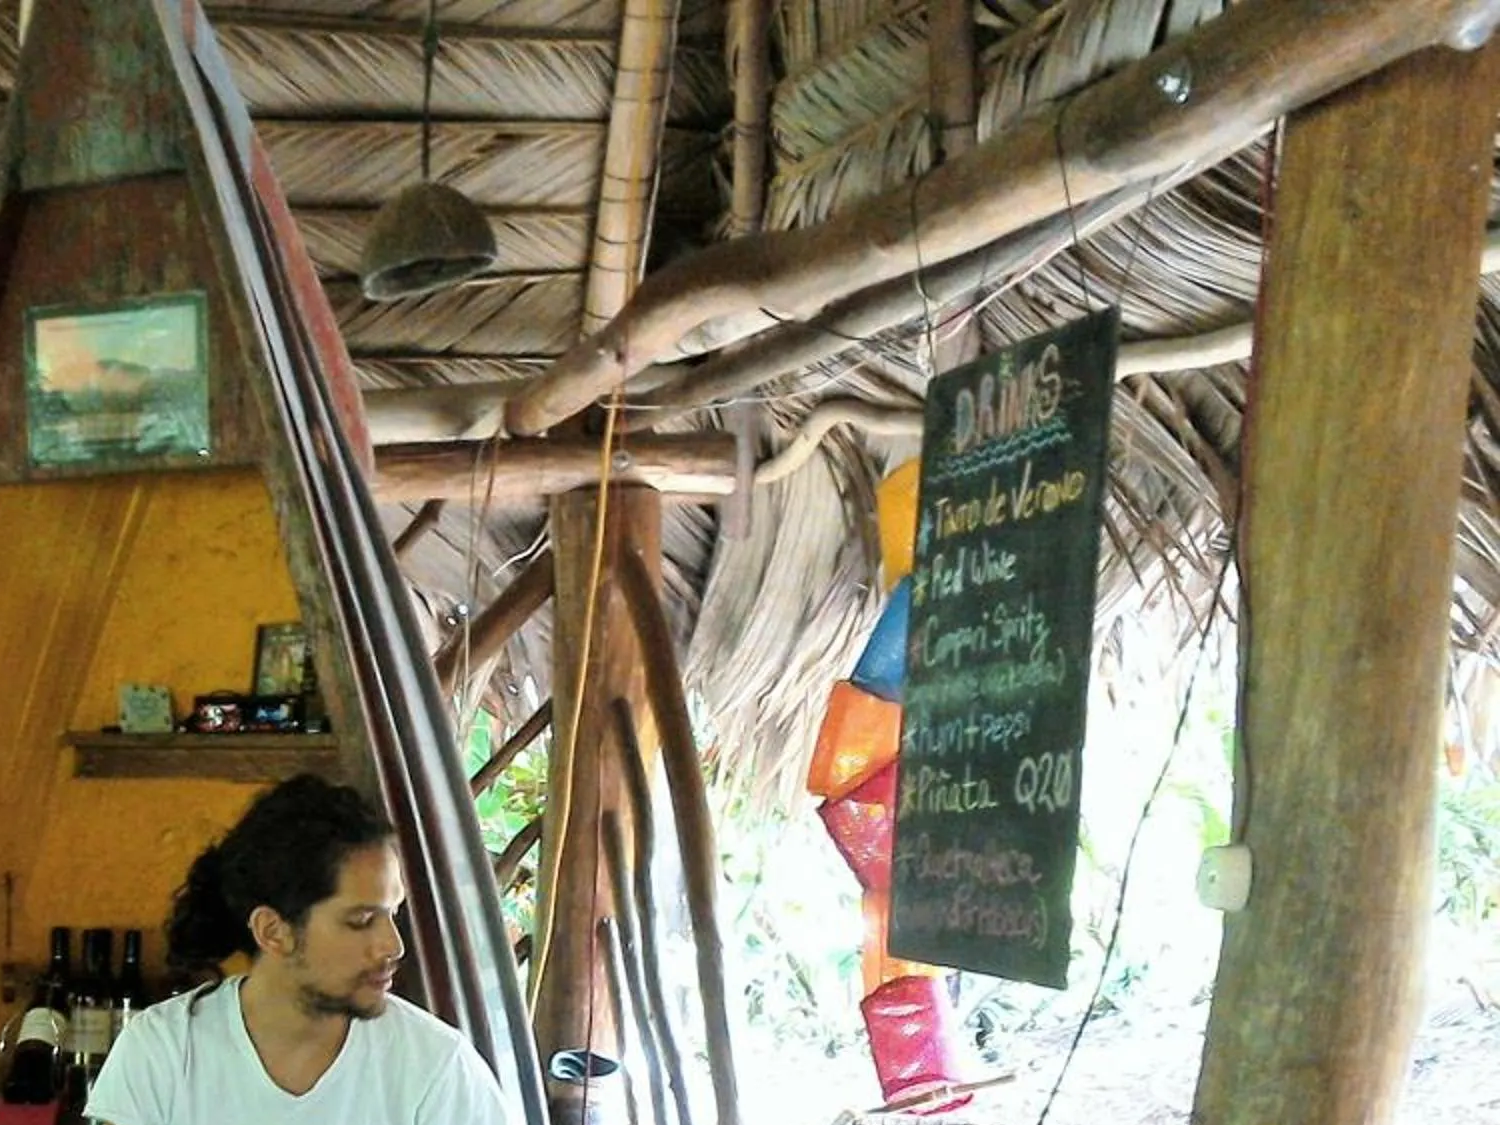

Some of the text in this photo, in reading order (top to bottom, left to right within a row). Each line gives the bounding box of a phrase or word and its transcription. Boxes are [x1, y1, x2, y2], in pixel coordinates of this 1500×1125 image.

[955, 343, 1063, 453] DRINKS
[1011, 460, 1086, 521] Verano
[931, 539, 1018, 601] Red Wine
[917, 751, 1072, 814] Piñata Q20
